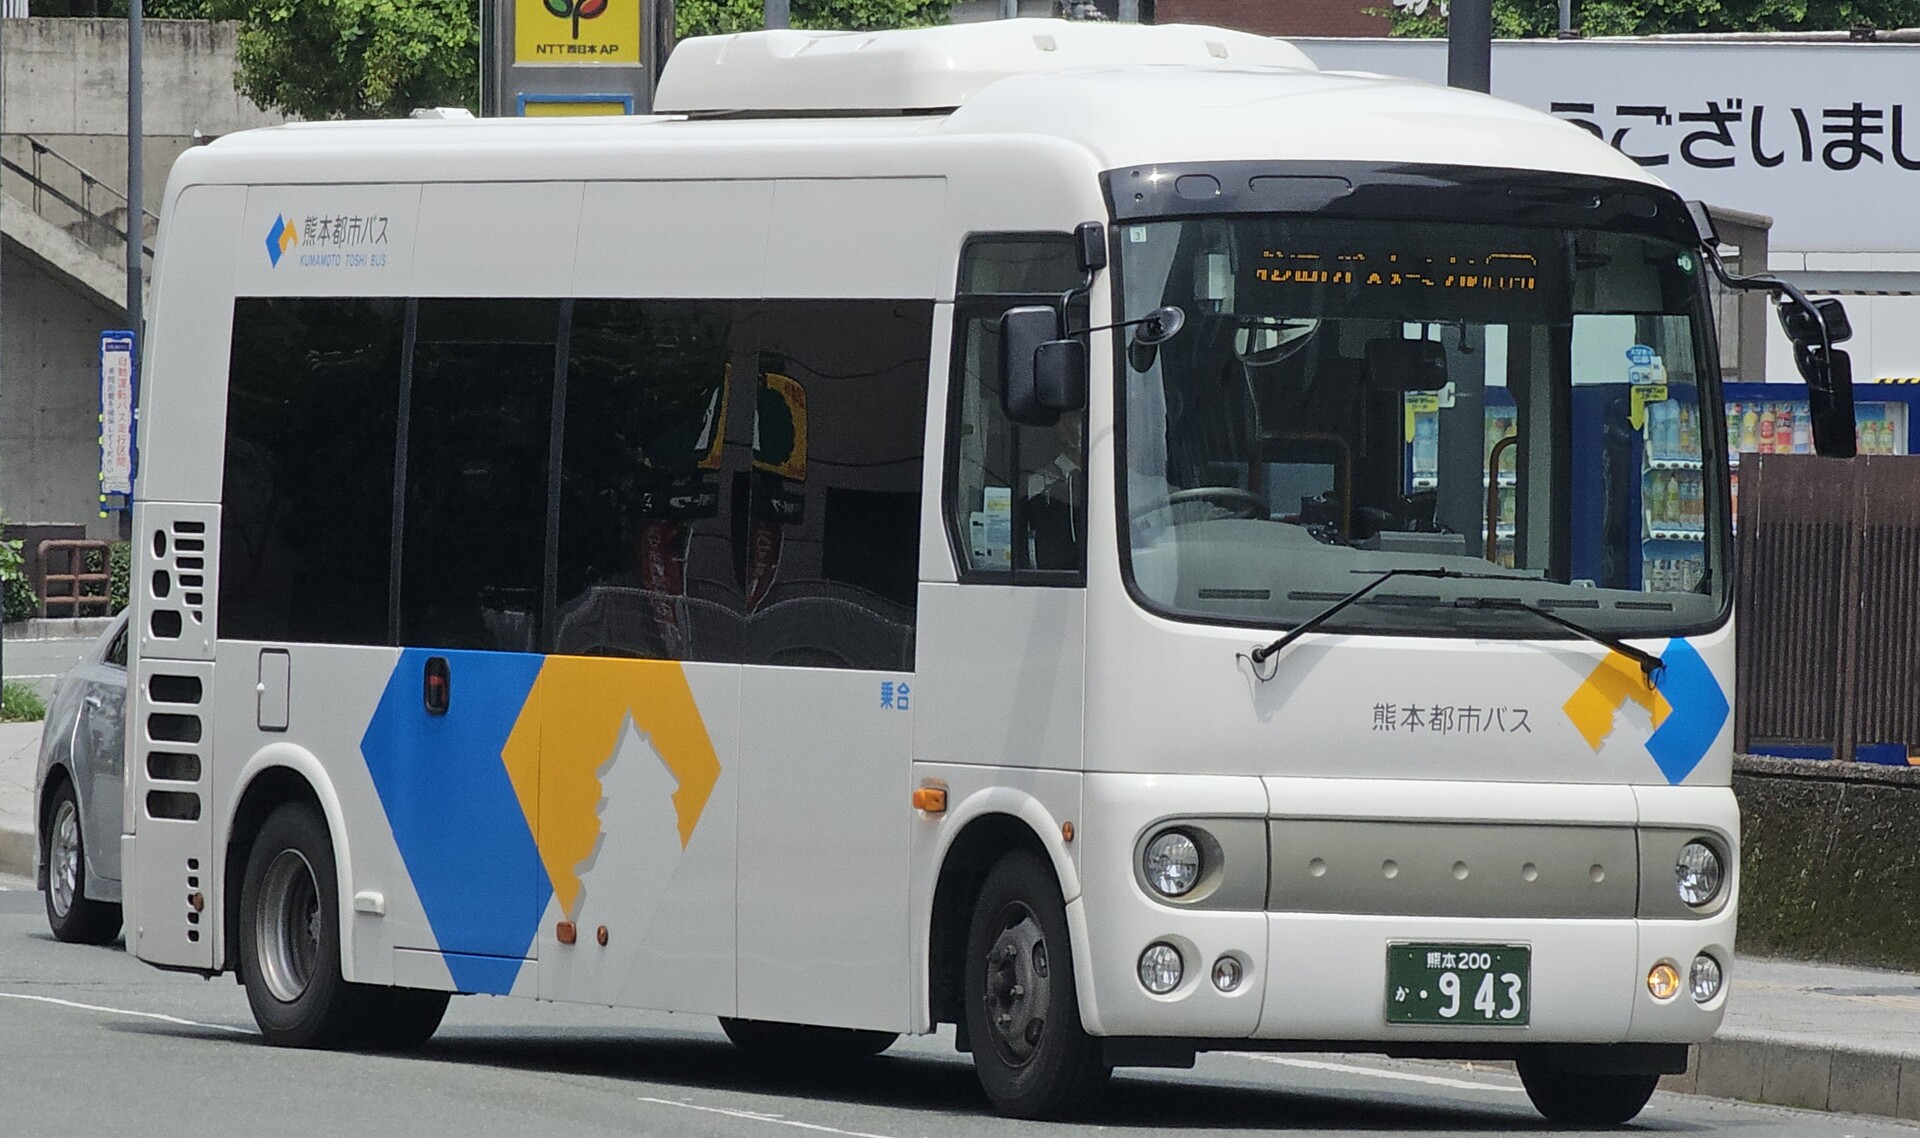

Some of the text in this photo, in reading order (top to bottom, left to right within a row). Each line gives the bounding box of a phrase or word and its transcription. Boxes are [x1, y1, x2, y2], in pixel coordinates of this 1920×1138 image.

[599, 44, 619, 55] AP
[301, 214, 389, 248] 熊本都市バス
[299, 253, 387, 267] KUMAMOTO TOSHI BUS
[880, 680, 910, 711] 乗合
[1372, 702, 1532, 735] 熊本都市バス
